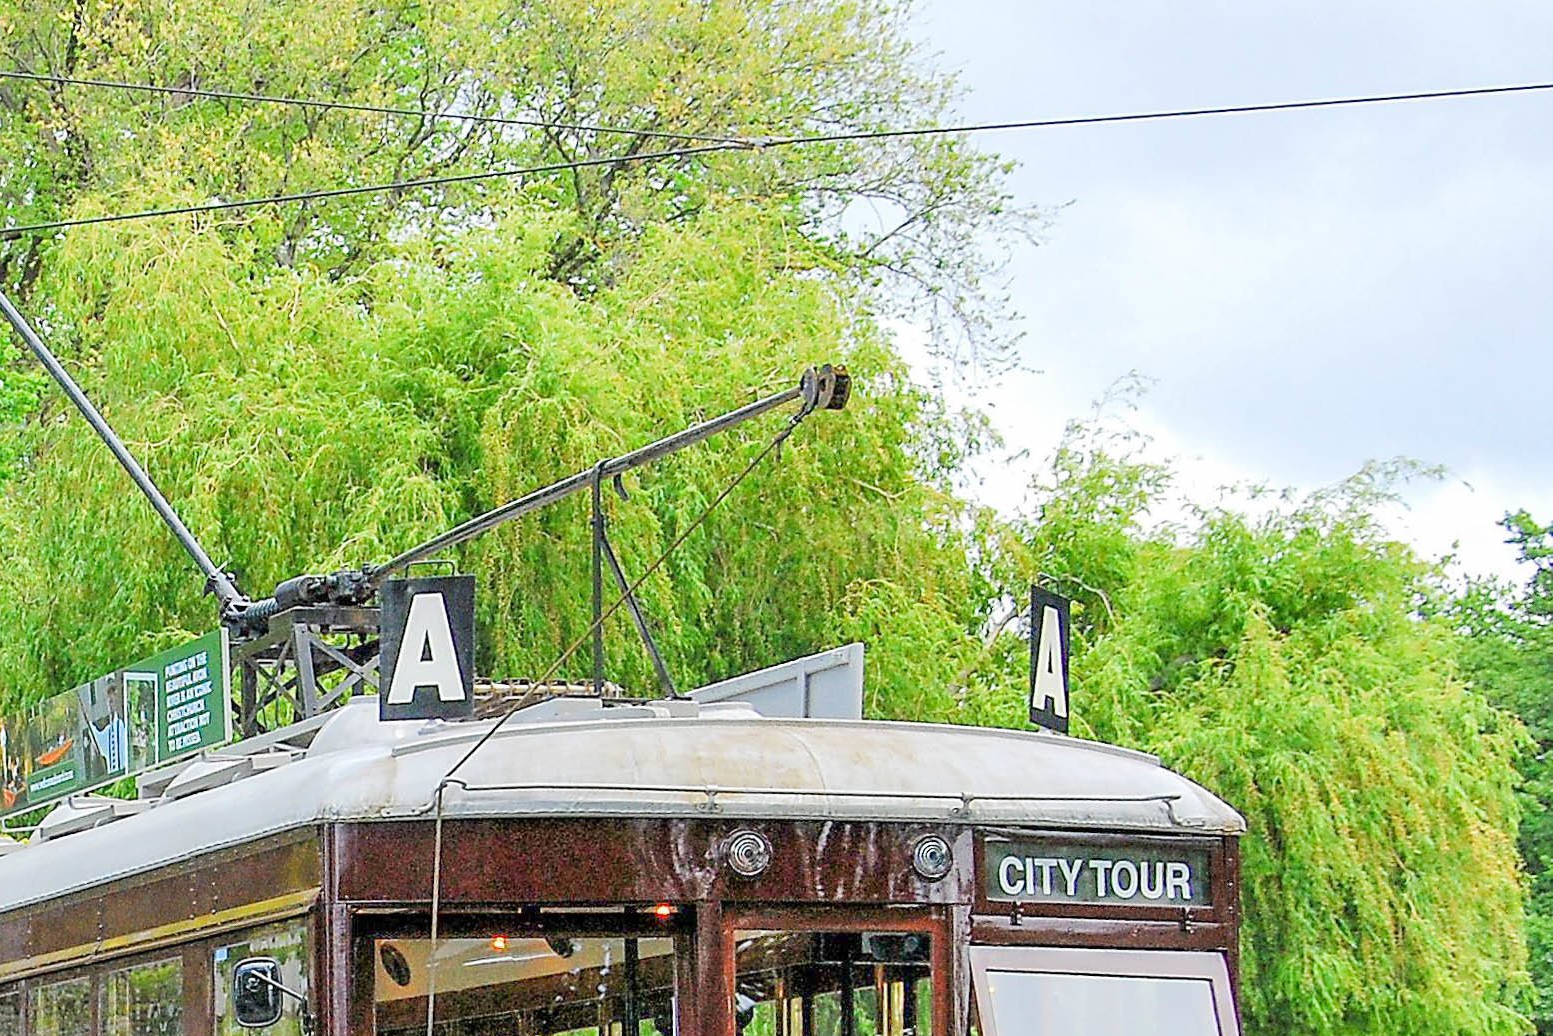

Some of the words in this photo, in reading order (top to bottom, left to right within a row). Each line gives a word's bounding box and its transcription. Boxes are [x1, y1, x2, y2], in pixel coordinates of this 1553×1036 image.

[387, 592, 466, 705] A
[1032, 605, 1067, 718] A
[998, 855, 1087, 897] CITY
[1089, 858, 1192, 900] TOUR
